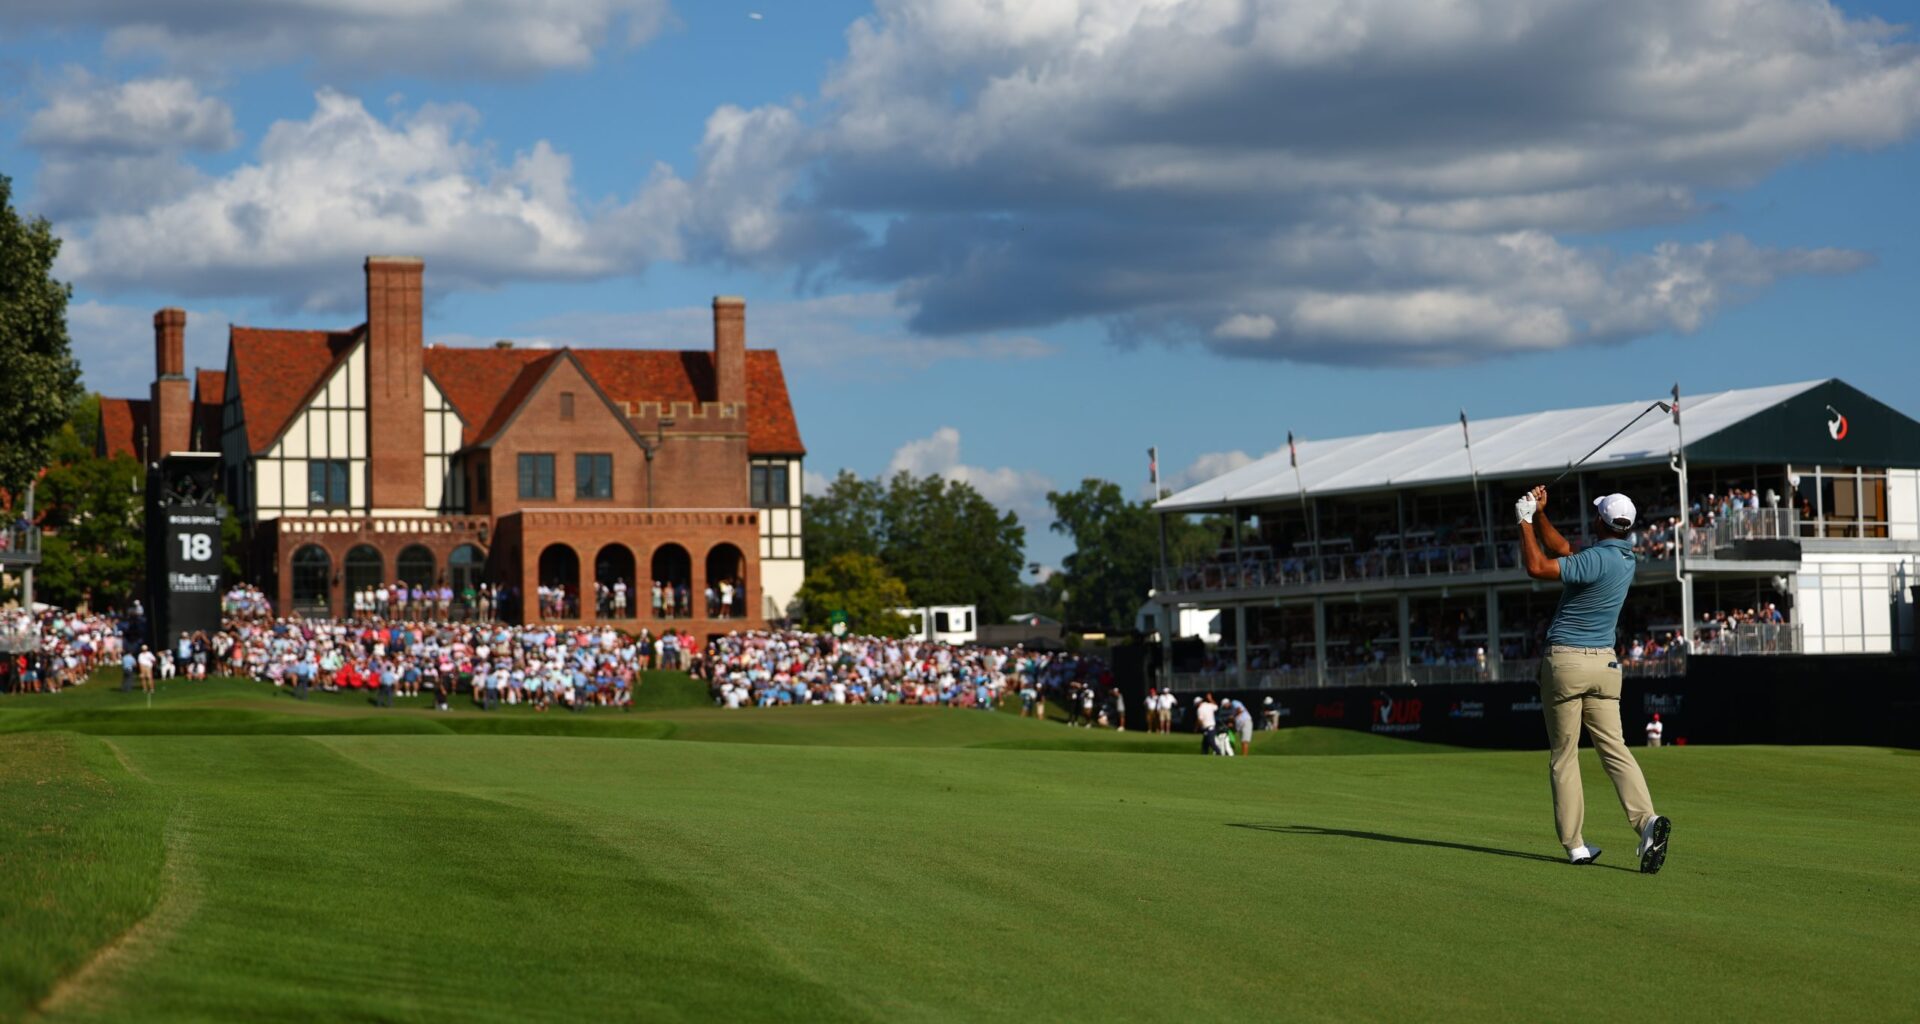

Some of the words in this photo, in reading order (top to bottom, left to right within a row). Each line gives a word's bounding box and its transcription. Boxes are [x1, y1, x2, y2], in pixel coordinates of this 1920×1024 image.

[191, 515, 220, 526] SPORT
[177, 533, 212, 561] 18
[1371, 698, 1423, 724] TOUR
